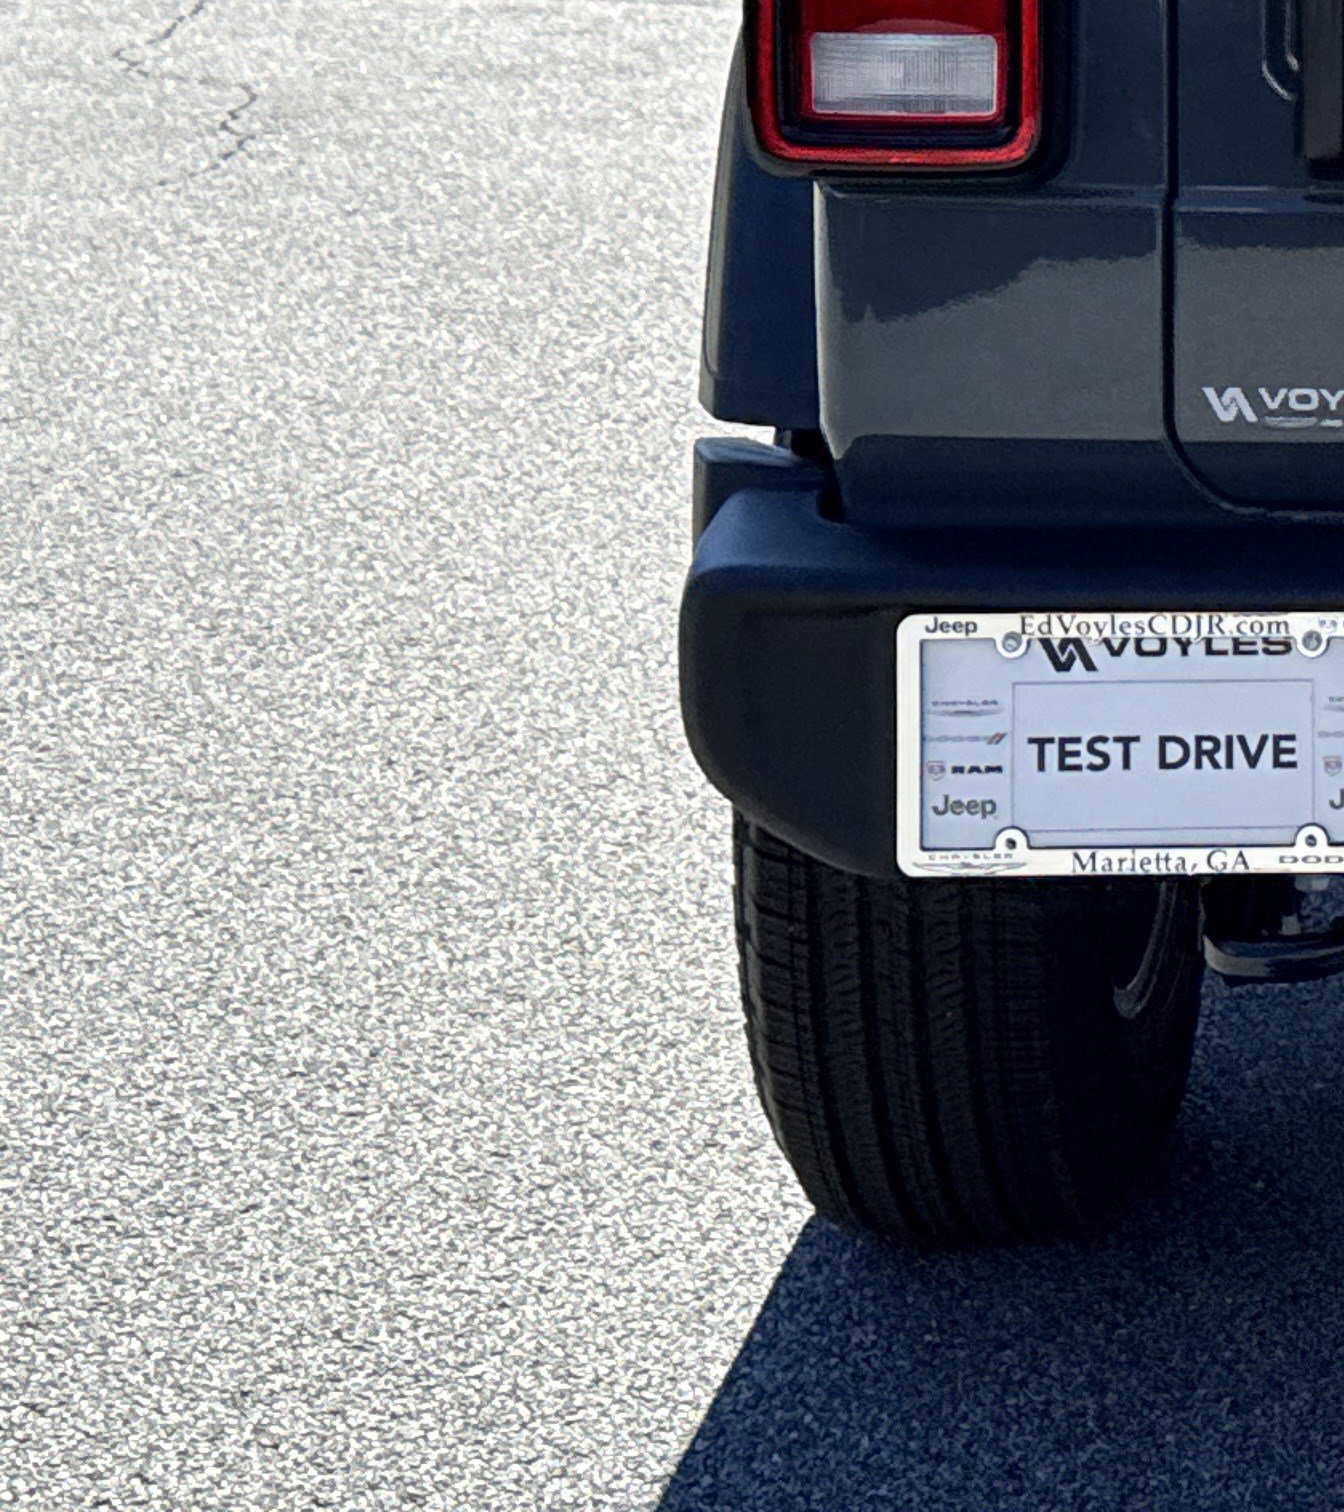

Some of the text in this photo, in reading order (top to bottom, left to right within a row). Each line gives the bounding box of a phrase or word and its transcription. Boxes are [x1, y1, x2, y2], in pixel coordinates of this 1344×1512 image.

[925, 617, 978, 636] Jeep
[1020, 614, 1290, 642] EdVoylesCDJR.com
[1101, 637, 1293, 657] VOYLES
[1027, 734, 1298, 773] TEST DRIVE
[951, 764, 1003, 775] RAM
[932, 794, 997, 819] Jeep
[1072, 848, 1250, 874] Marietta, GA
